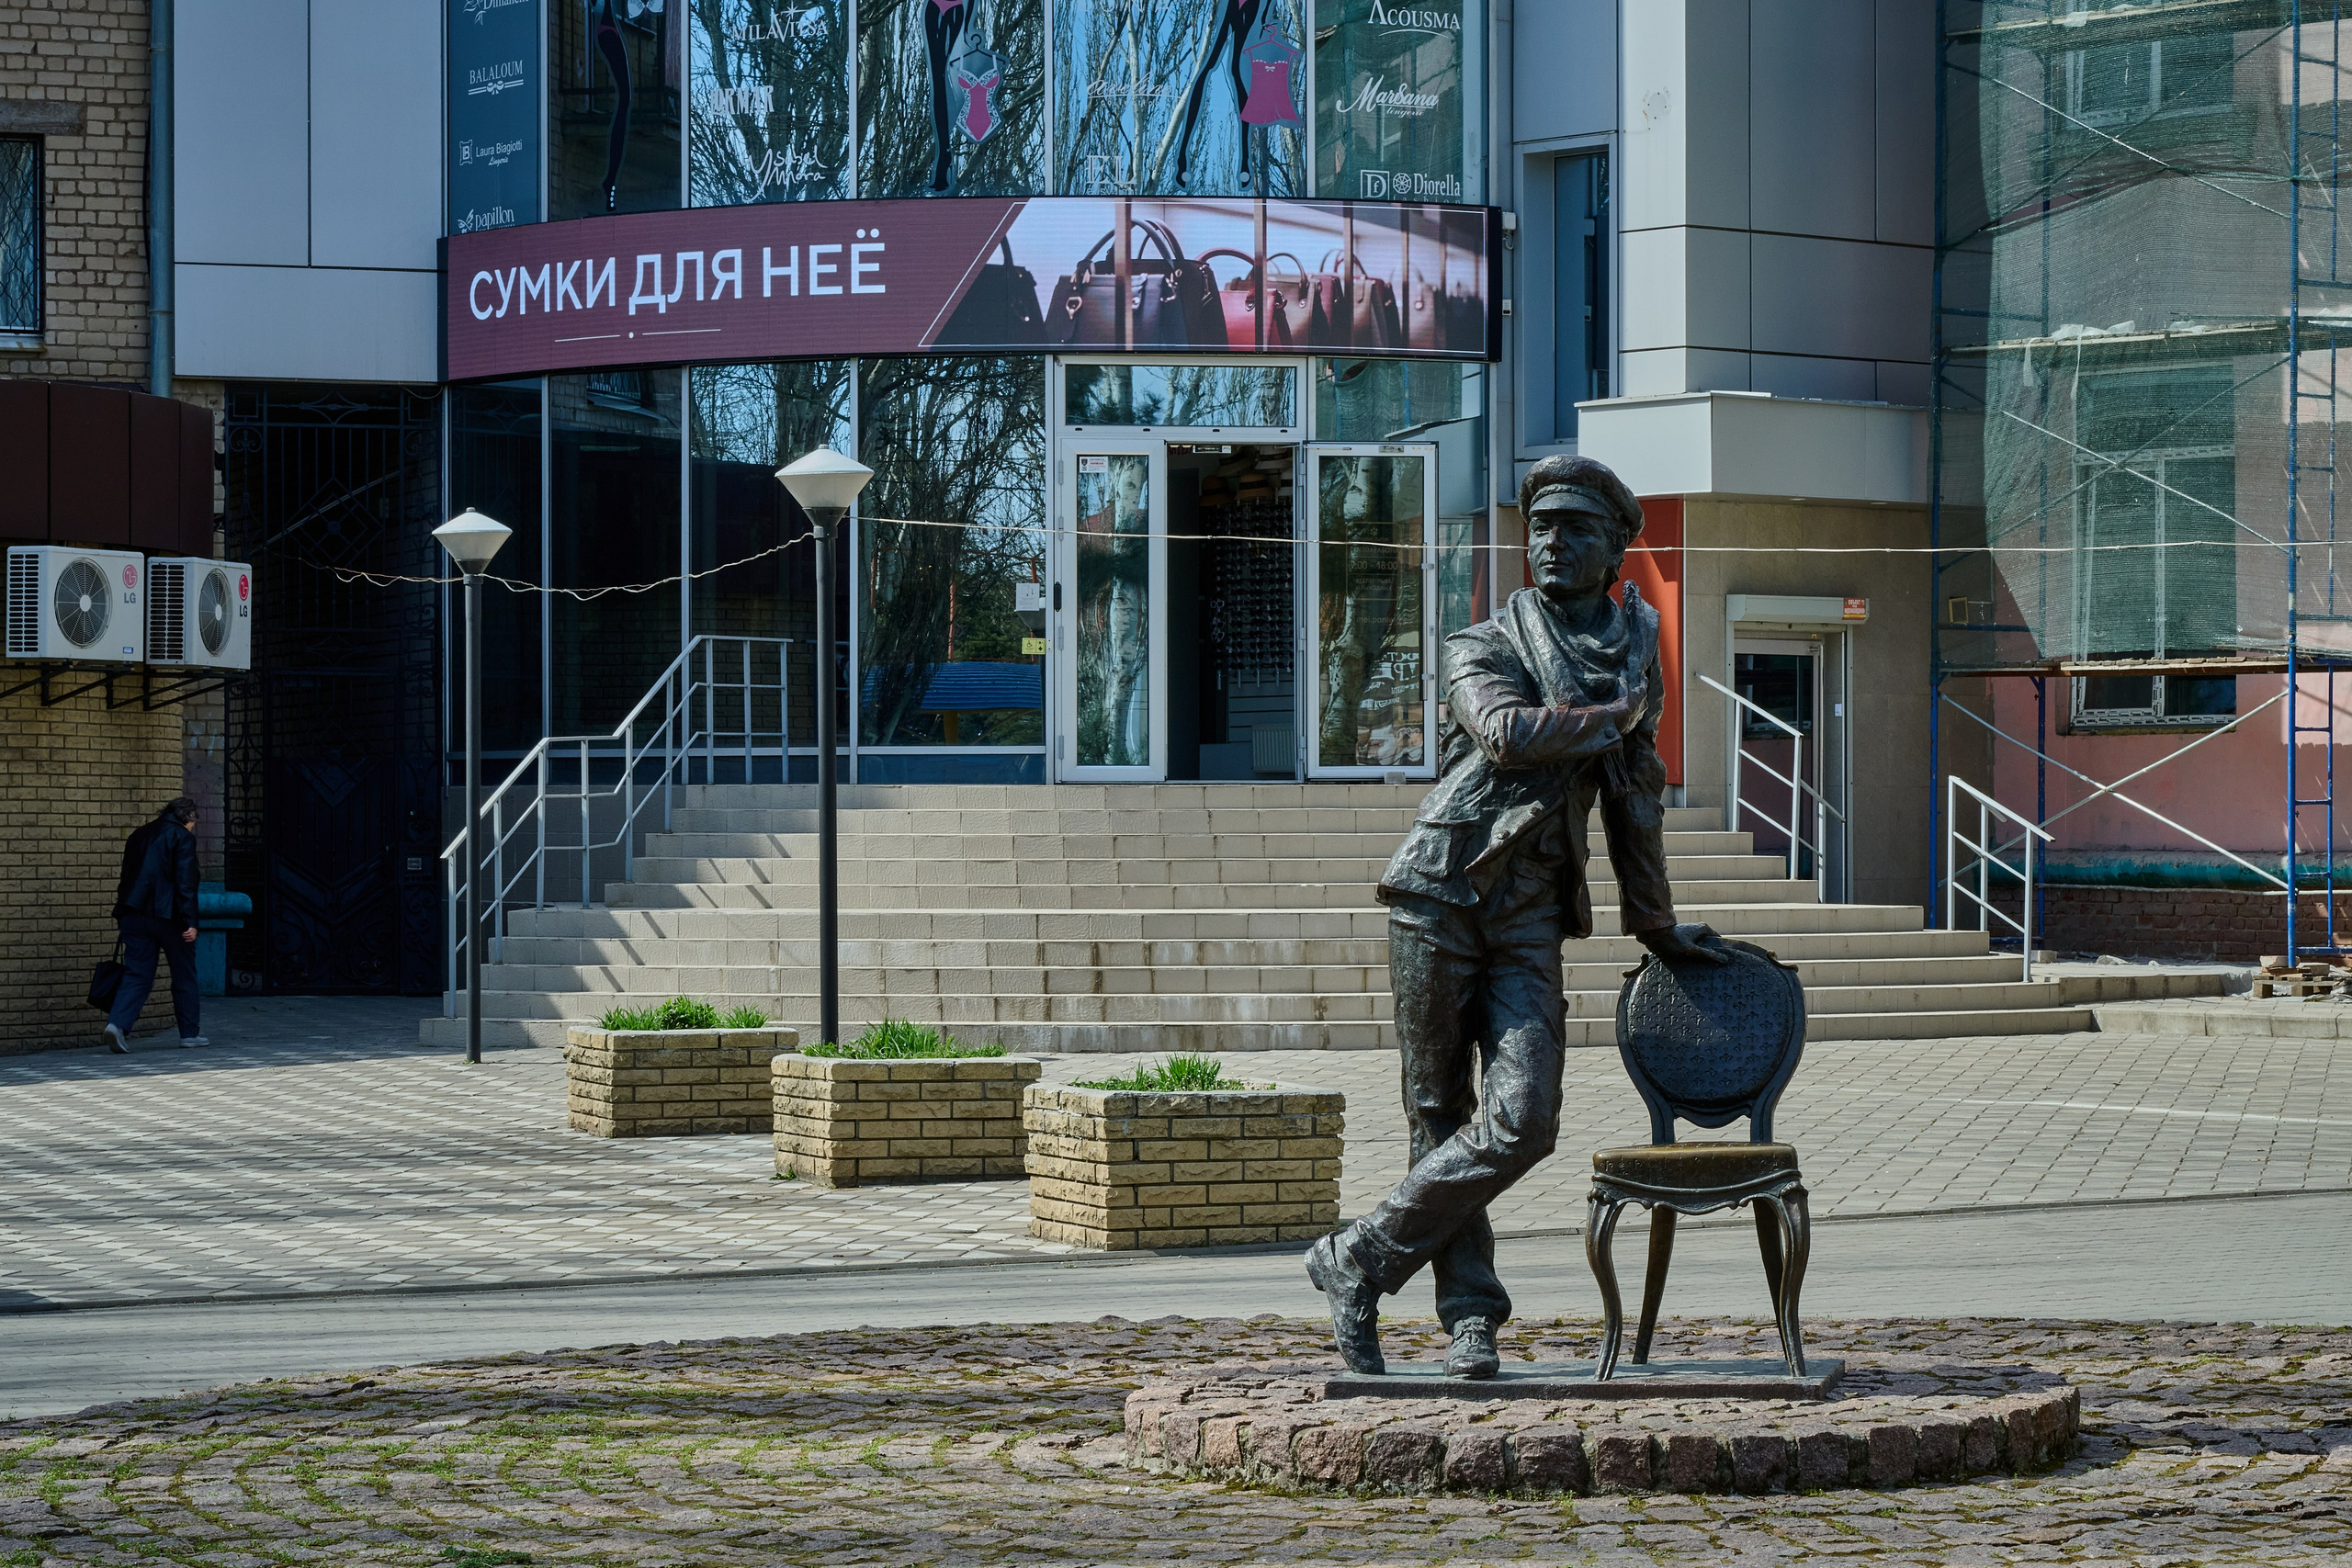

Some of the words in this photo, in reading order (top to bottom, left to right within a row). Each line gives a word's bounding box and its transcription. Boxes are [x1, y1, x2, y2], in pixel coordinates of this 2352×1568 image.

[469, 60, 523, 85] BALALOUM
[476, 146, 495, 157] Laura
[496, 139, 523, 155] Biagiotti
[1413, 173, 1461, 197] Diorella
[475, 206, 515, 231] papillon
[469, 256, 616, 321] СУМКИ
[628, 248, 742, 316] ДЛЯ
[763, 228, 887, 298] НЕЁ
[123, 592, 137, 604] LG
[239, 605, 248, 617] LG
